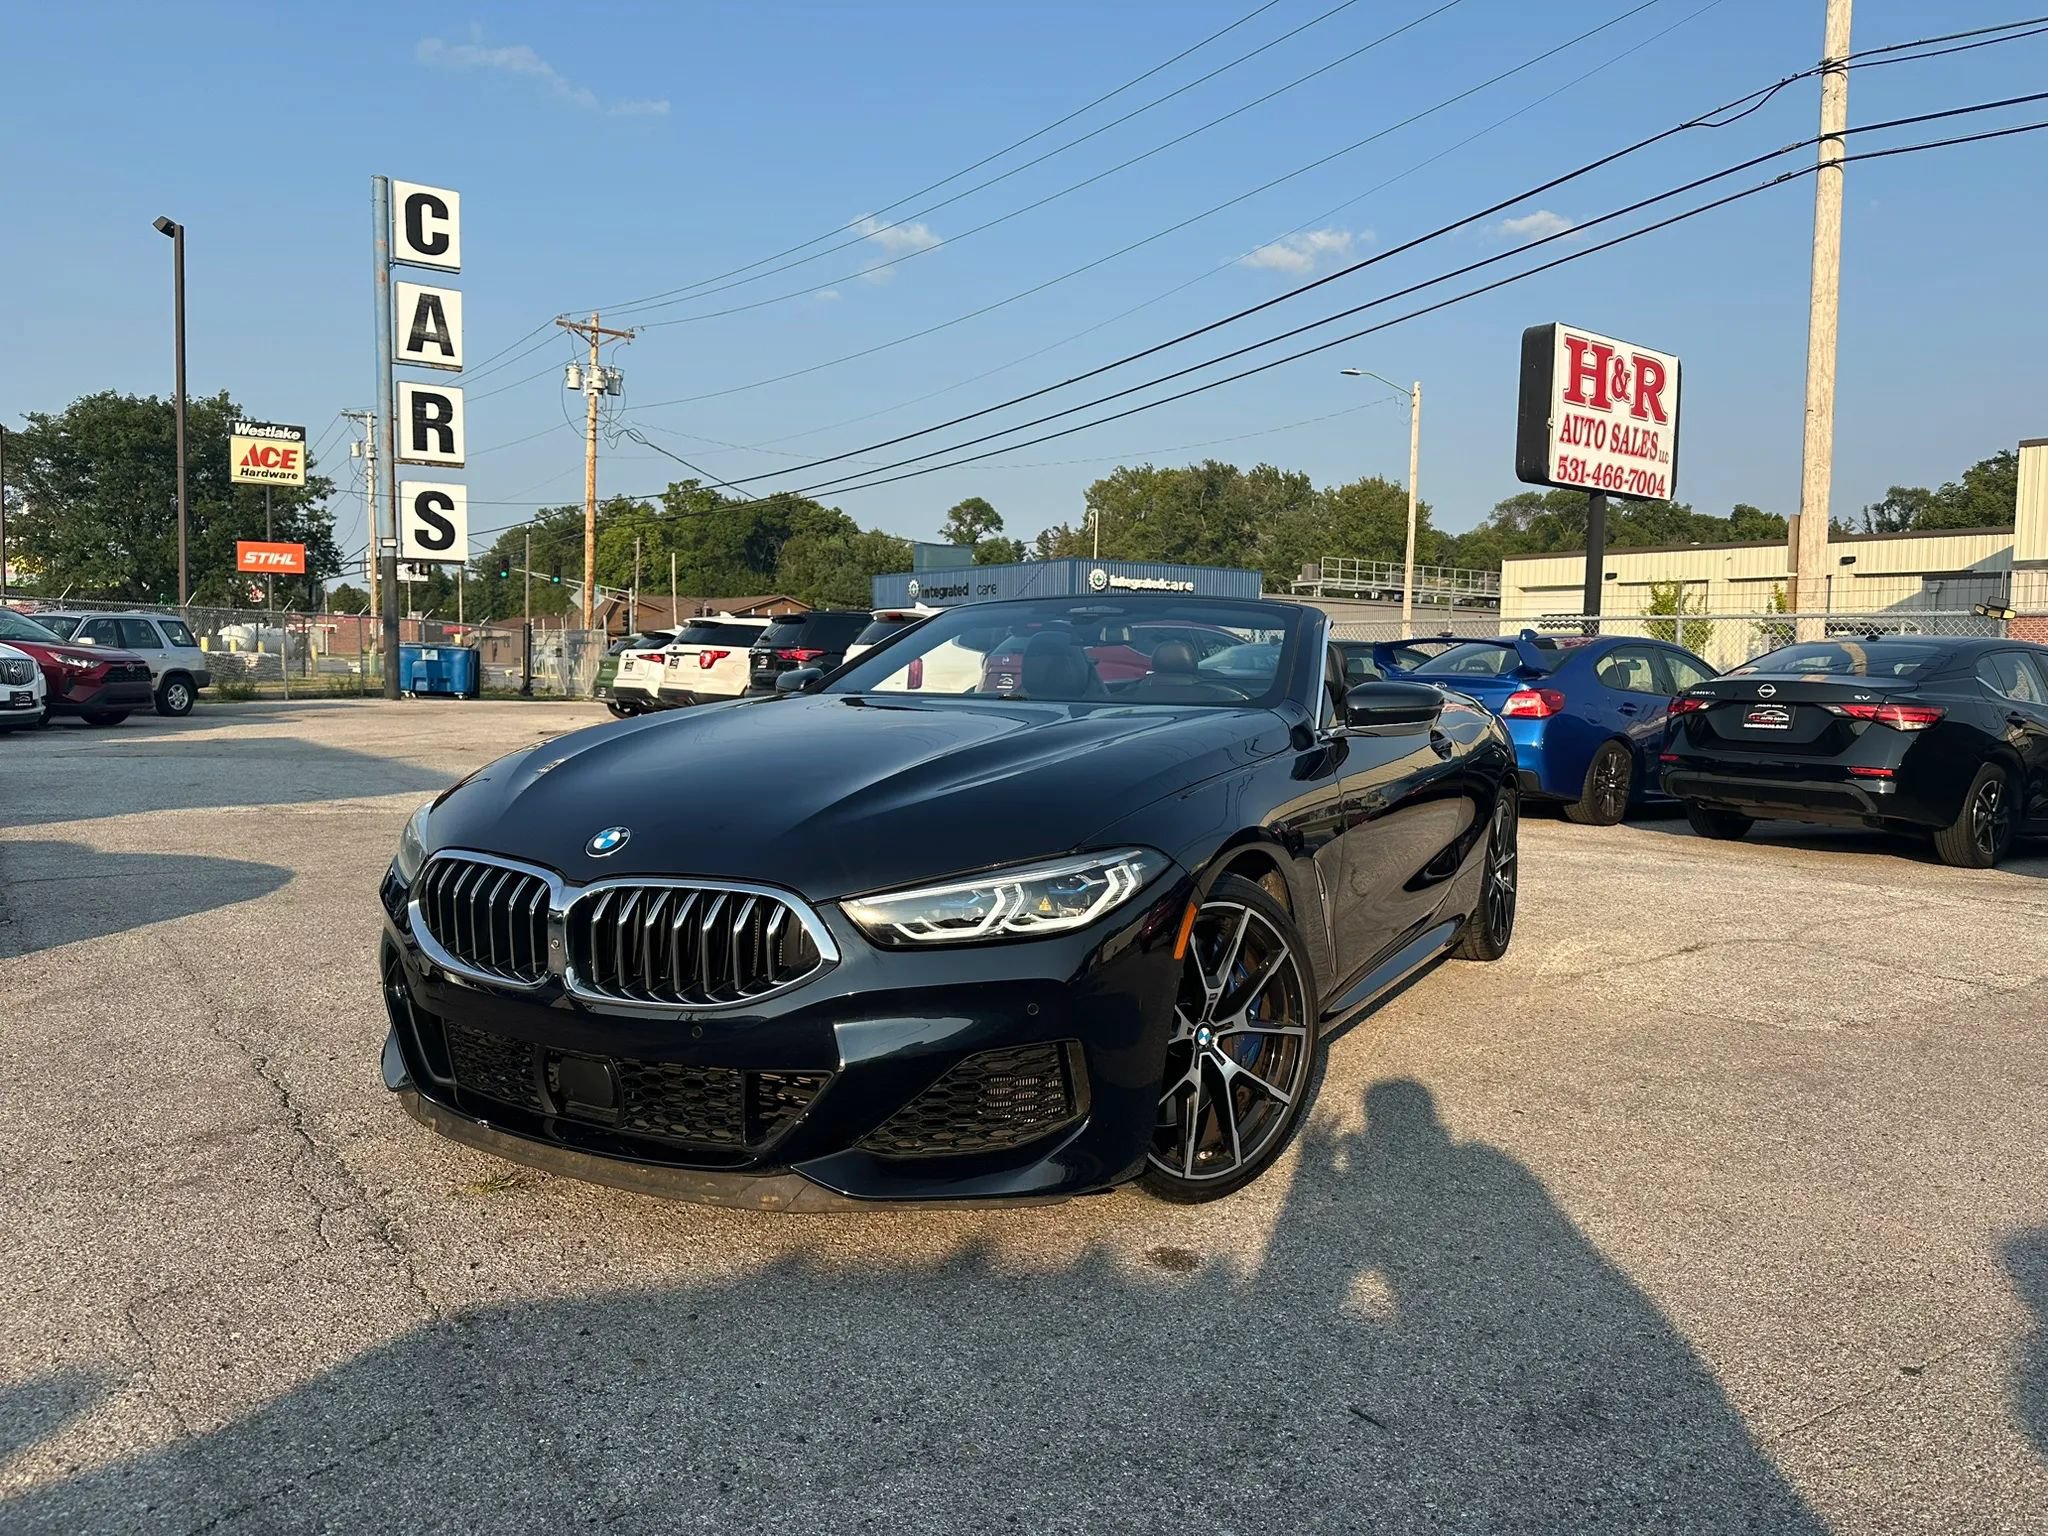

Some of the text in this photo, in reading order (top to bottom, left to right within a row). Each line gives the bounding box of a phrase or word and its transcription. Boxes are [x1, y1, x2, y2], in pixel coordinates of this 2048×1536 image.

[405, 193, 455, 551] CARS
[1563, 333, 1668, 425] H&R
[235, 422, 300, 440] Westlake
[1560, 413, 1606, 449] AUTO
[1610, 423, 1658, 460] SALES
[240, 443, 298, 469] ACE
[240, 467, 298, 480] Hardware
[1557, 454, 1665, 497] 531-466-7004
[243, 551, 297, 566] STIHL
[921, 583, 997, 599] integrated care
